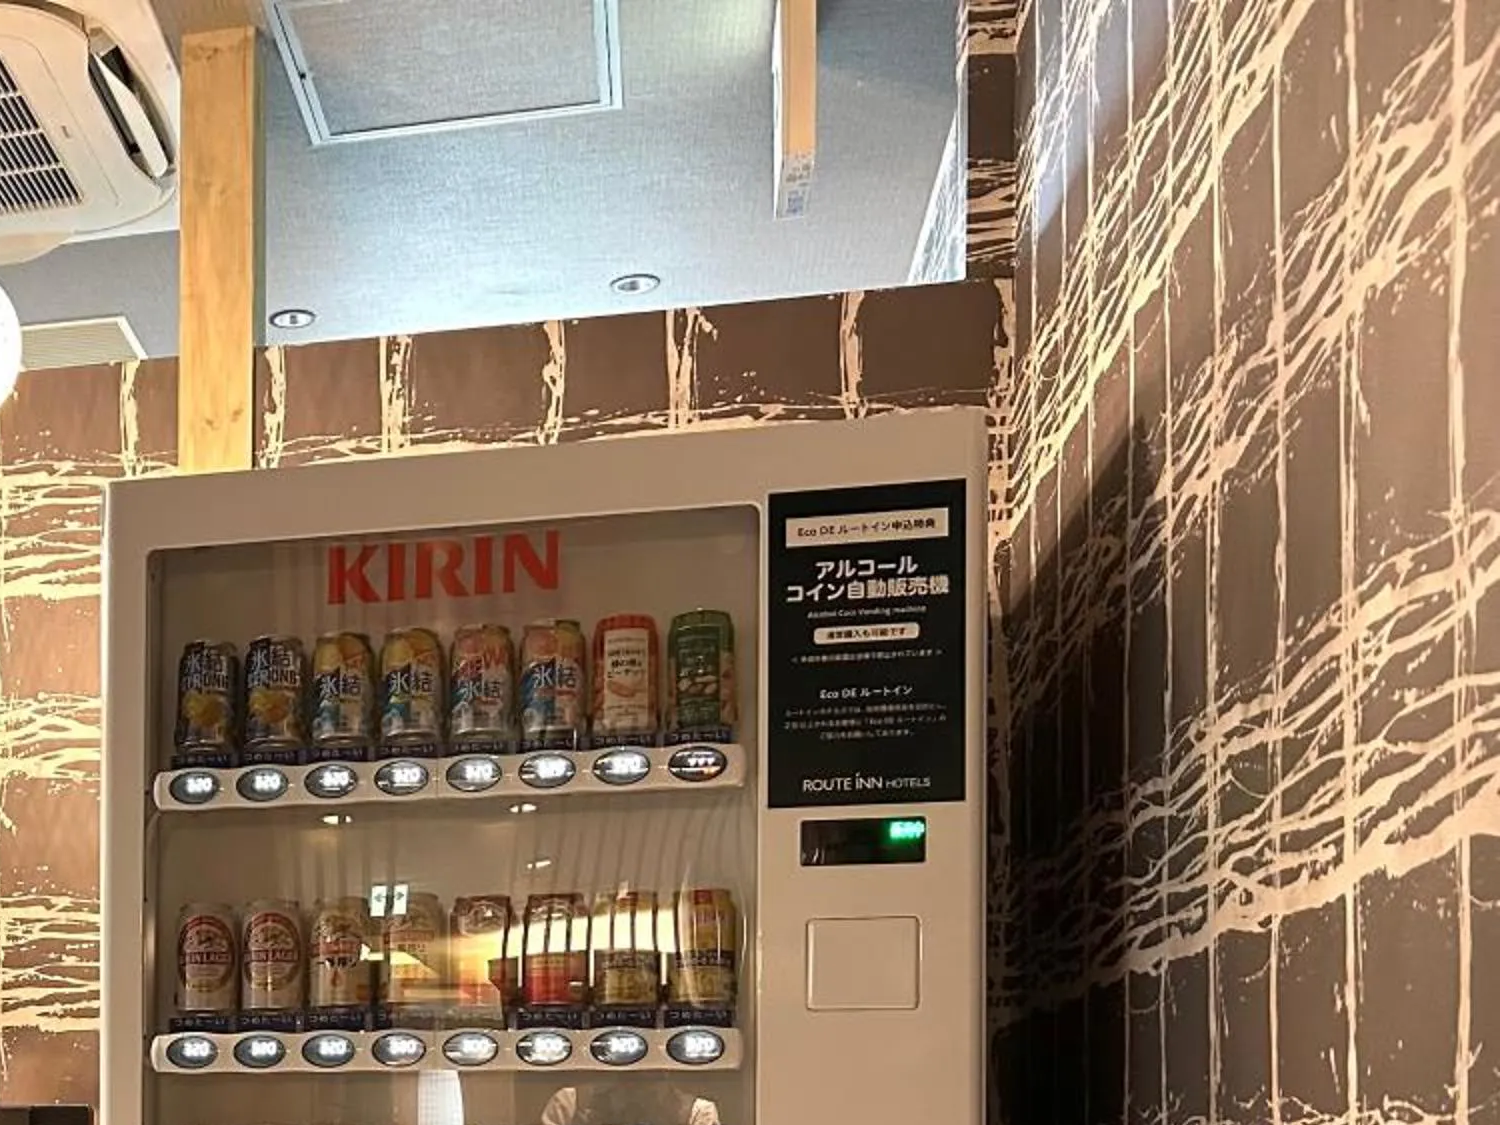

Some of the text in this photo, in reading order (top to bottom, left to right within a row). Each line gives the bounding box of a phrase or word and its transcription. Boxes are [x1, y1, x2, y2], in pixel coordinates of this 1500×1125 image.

[797, 526, 817, 538] Eco
[819, 525, 835, 536] DE
[328, 530, 559, 605] KIRIN
[815, 555, 918, 580] アルコール
[786, 575, 949, 602] コイン自動販売機
[389, 671, 435, 696] 氷結
[532, 664, 578, 690] 氷結
[820, 689, 839, 699] Eco
[860, 684, 913, 698] ルートイン
[803, 777, 852, 792] ROUTE
[886, 776, 931, 789] HOTELS
